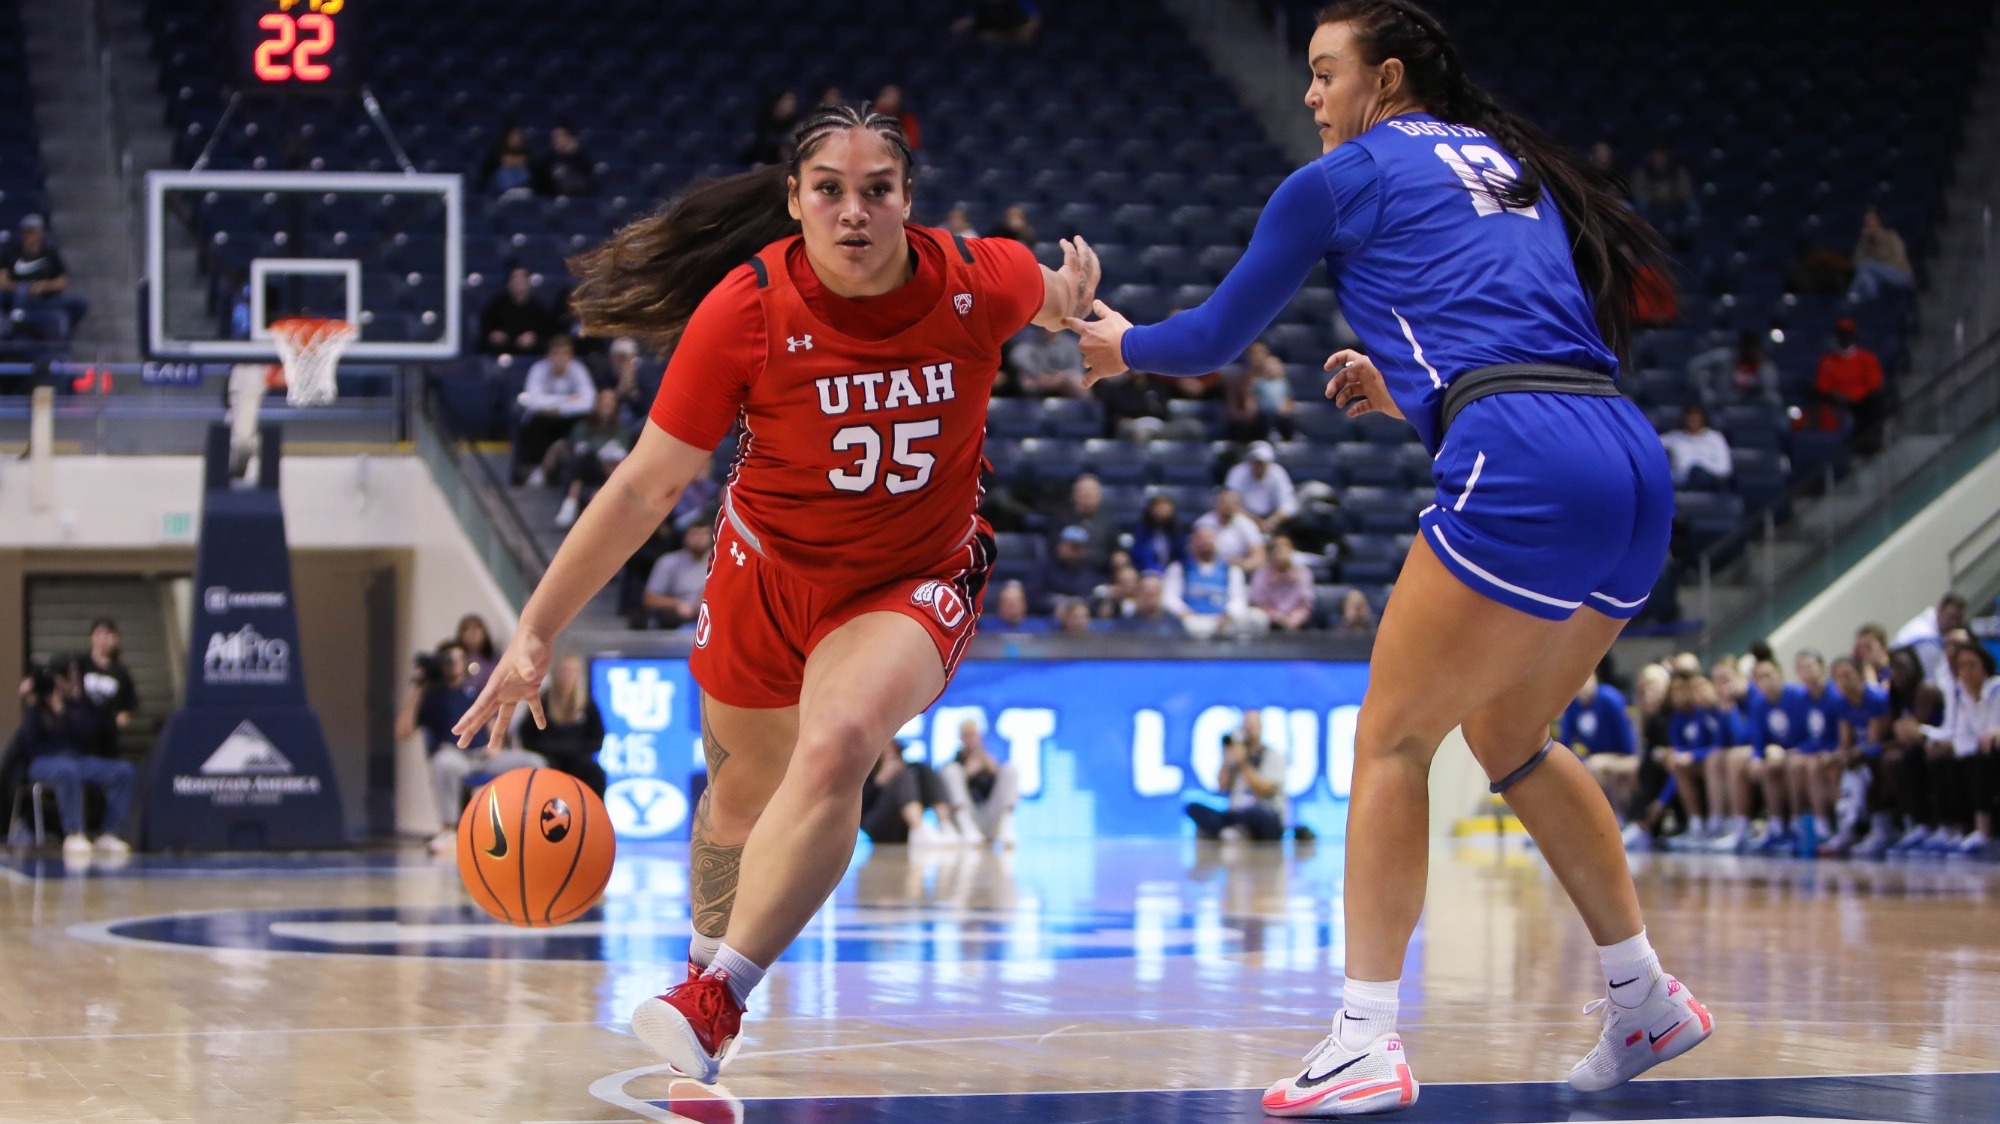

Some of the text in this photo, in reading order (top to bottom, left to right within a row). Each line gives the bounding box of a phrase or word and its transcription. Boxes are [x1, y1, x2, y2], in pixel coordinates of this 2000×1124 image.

[254, 13, 335, 81] 22
[1434, 143, 1540, 220] 12
[953, 293, 972, 309] PAC
[815, 362, 955, 415] UTAH
[828, 418, 940, 495] 35
[617, 791, 666, 826] Y
